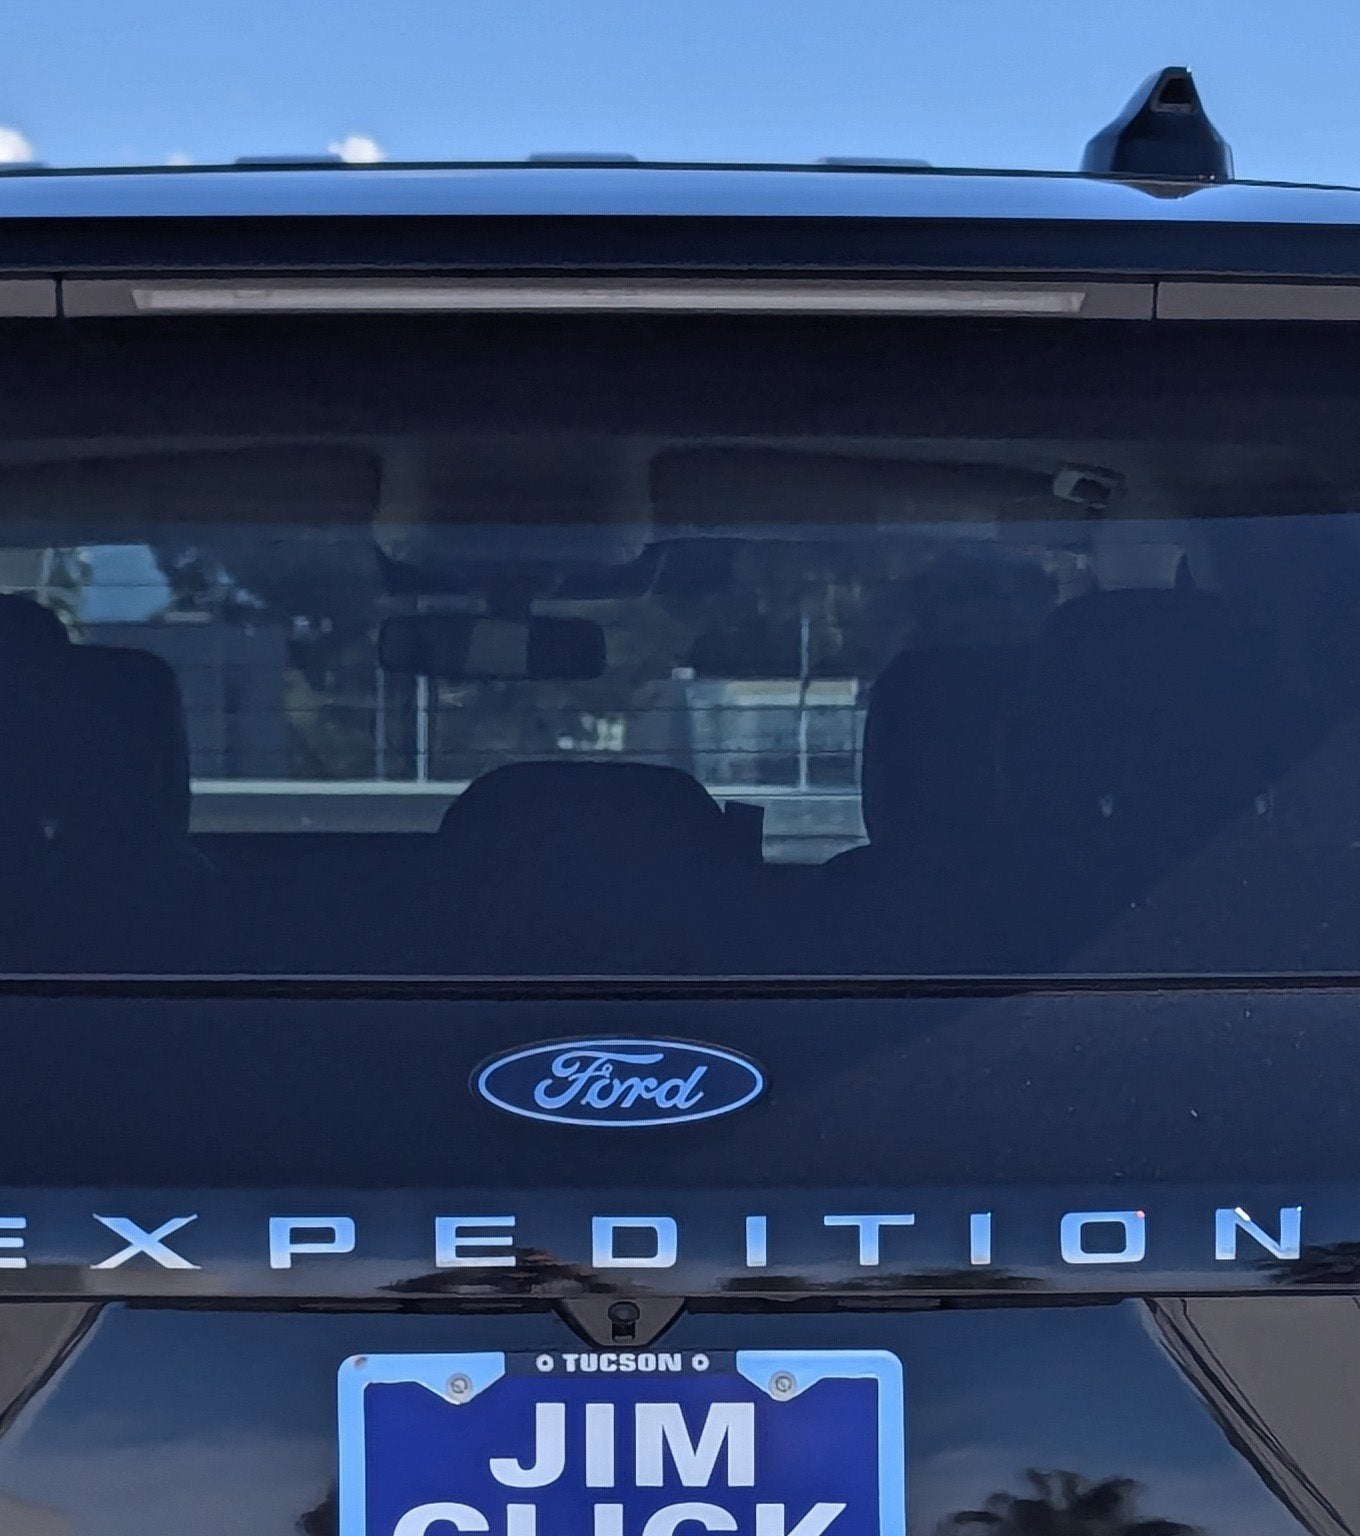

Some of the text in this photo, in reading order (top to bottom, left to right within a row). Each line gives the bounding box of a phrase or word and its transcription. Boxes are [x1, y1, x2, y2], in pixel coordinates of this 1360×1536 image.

[533, 1050, 708, 1110] Ford
[562, 1353, 683, 1373] TUCSON
[489, 1401, 756, 1488] JIM
